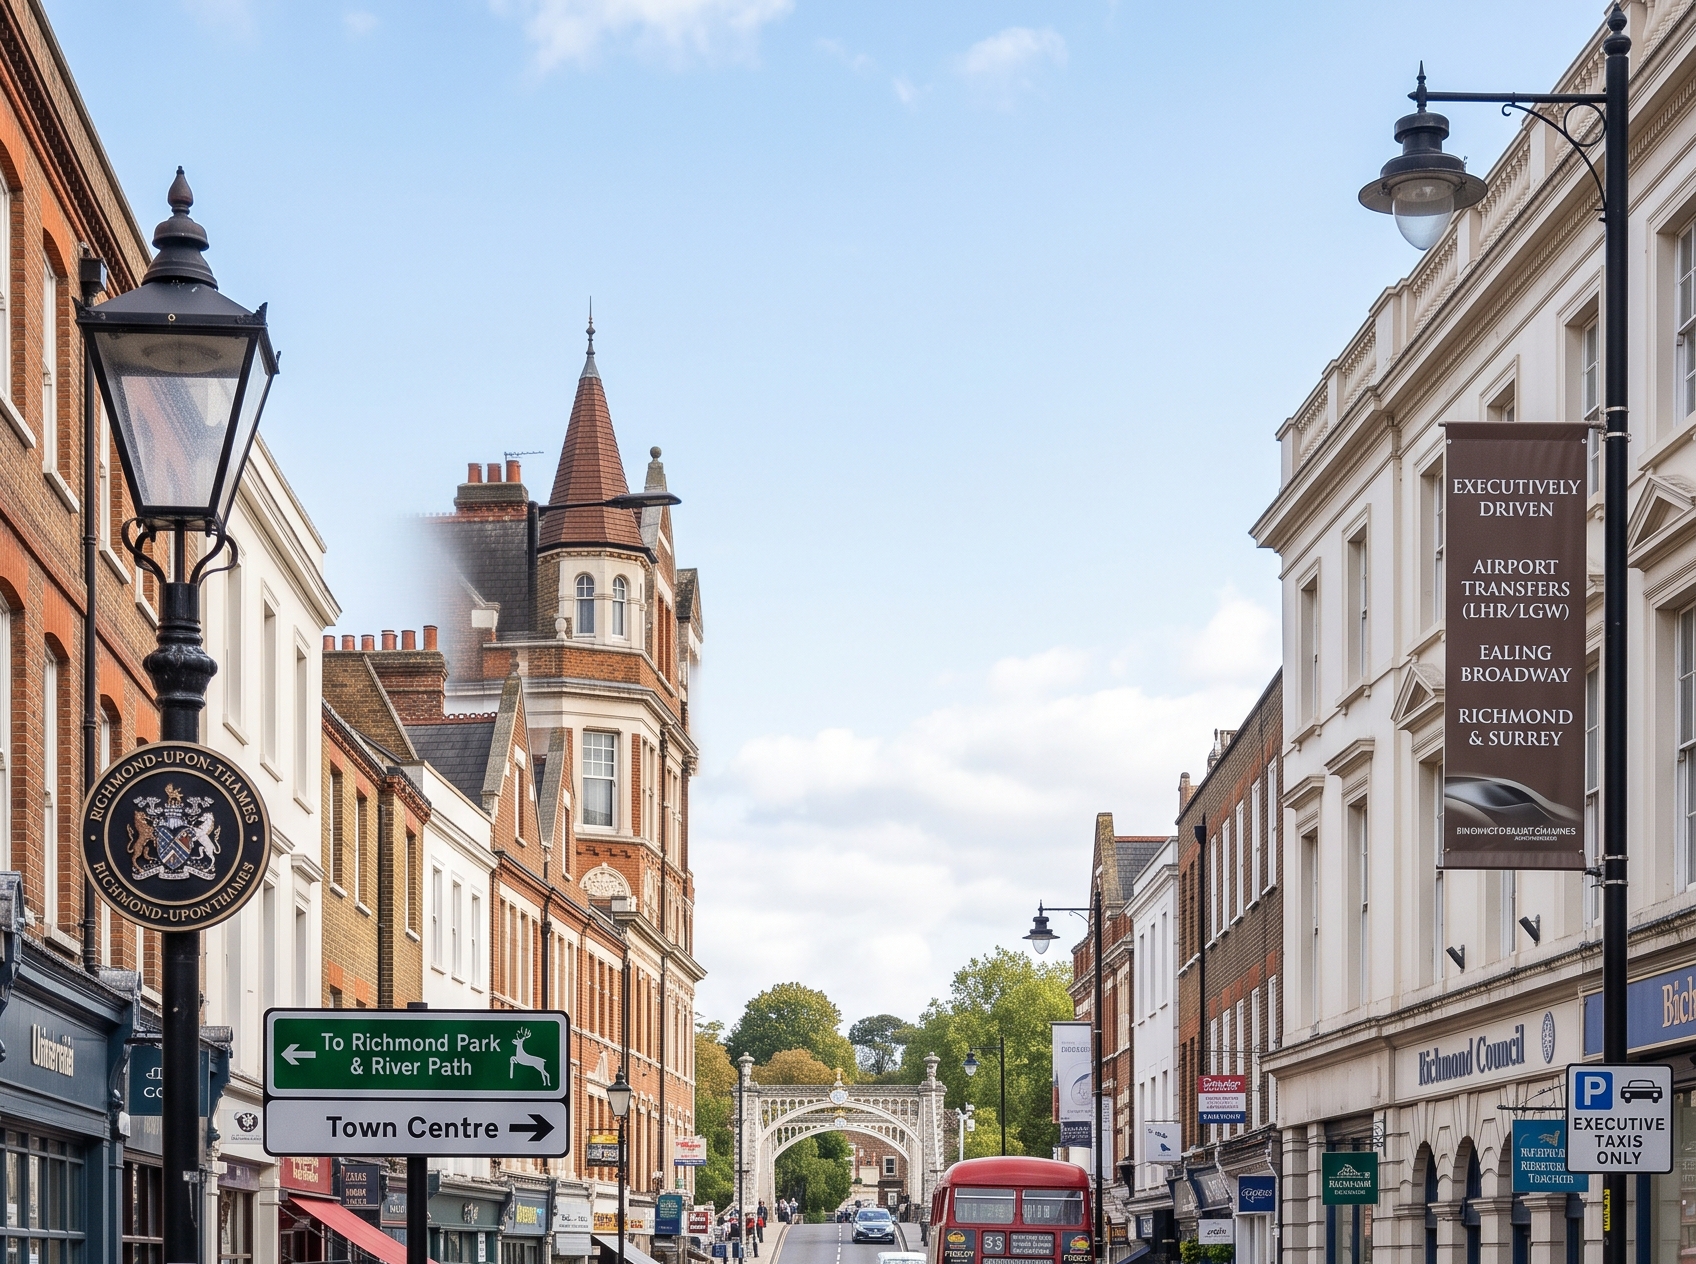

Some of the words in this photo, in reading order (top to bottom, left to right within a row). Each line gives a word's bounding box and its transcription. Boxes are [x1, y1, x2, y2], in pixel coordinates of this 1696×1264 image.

[1453, 478, 1581, 495] EXECUTIVELY
[1479, 501, 1554, 517] DRIVEN
[1472, 559, 1559, 575] AIRPORT
[1461, 581, 1570, 597] TRANSFERS
[1462, 602, 1570, 621] (LHR/LGW)
[1479, 644, 1552, 661] EALING
[1460, 666, 1573, 683] BROADWAY
[1458, 708, 1574, 725] RICHMOND
[1468, 730, 1485, 746] &
[1488, 730, 1563, 747] SURREY
[90, 751, 259, 824] RICHMOND-UPON-THAMES
[321, 1032, 344, 1051] To
[352, 1033, 449, 1052] Richmond
[457, 1034, 501, 1052] Park
[1418, 1037, 1473, 1086] Richmond
[1476, 1023, 1525, 1074] Council
[350, 1057, 364, 1075] &
[371, 1057, 420, 1075] River
[428, 1058, 472, 1076] Path
[1584, 1076, 1607, 1106] P
[326, 1115, 397, 1138] Town
[407, 1115, 499, 1139] Centre
[1573, 1117, 1665, 1131] EXECUTIVE
[1594, 1134, 1643, 1148] TAXIS
[1596, 1151, 1642, 1165] ONLY
